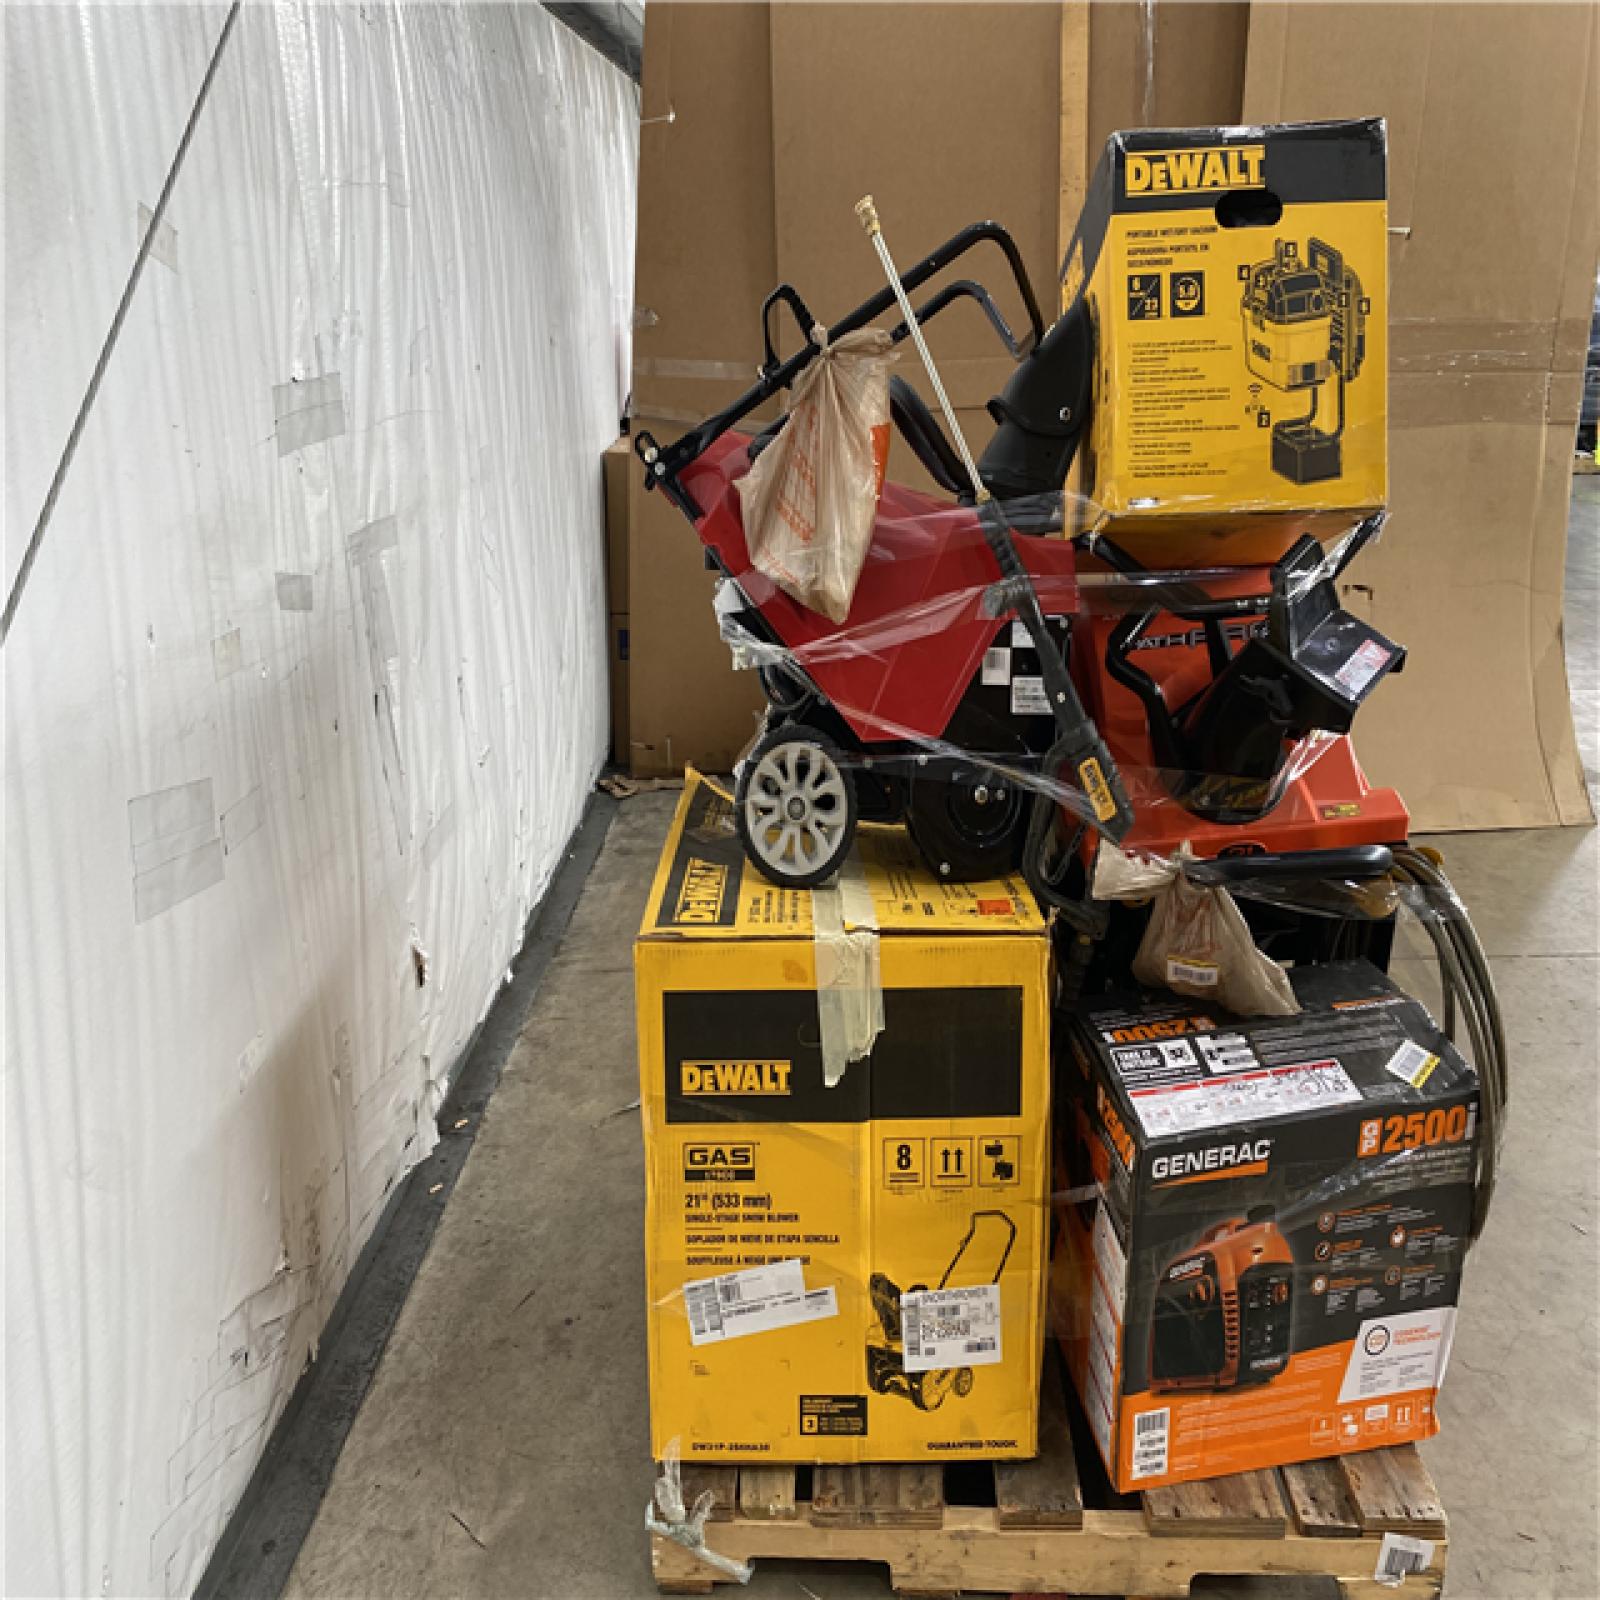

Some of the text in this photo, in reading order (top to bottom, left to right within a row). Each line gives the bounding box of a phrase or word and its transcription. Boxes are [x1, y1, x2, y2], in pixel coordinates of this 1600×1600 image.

[1126, 149, 1265, 192] DEWALT
[682, 1064, 791, 1092] DEWALT
[1382, 1102, 1478, 1153] 2500i
[689, 1147, 751, 1166] GAS
[896, 1144, 911, 1171] 8
[1151, 1139, 1272, 1180] GENERAC
